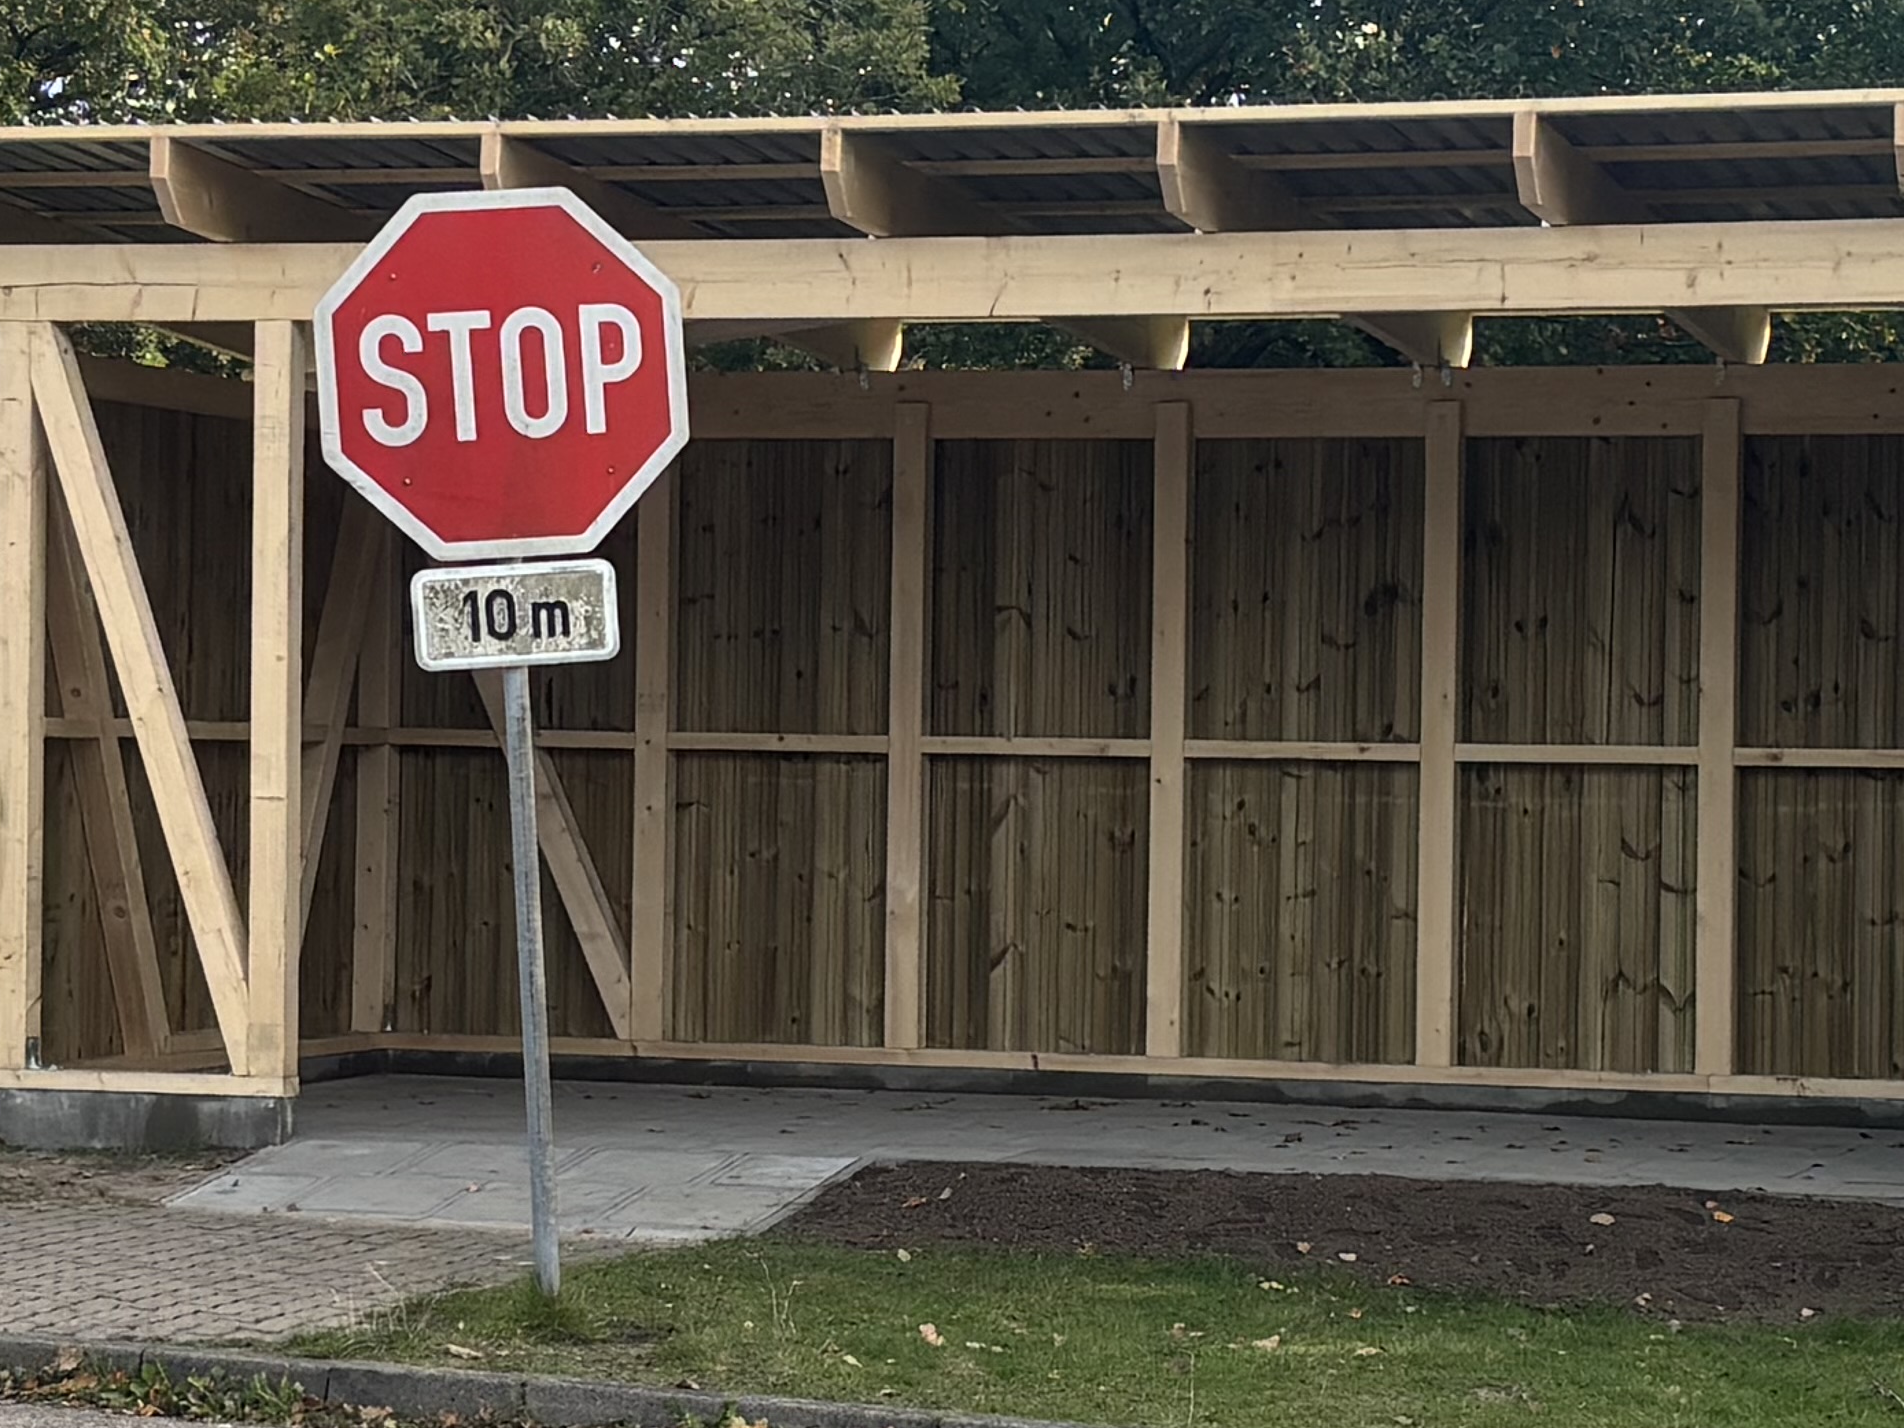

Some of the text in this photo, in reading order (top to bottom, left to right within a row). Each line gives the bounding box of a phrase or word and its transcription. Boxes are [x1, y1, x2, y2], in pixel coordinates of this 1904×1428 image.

[358, 303, 642, 447] STOP
[463, 588, 571, 643] 10 m
